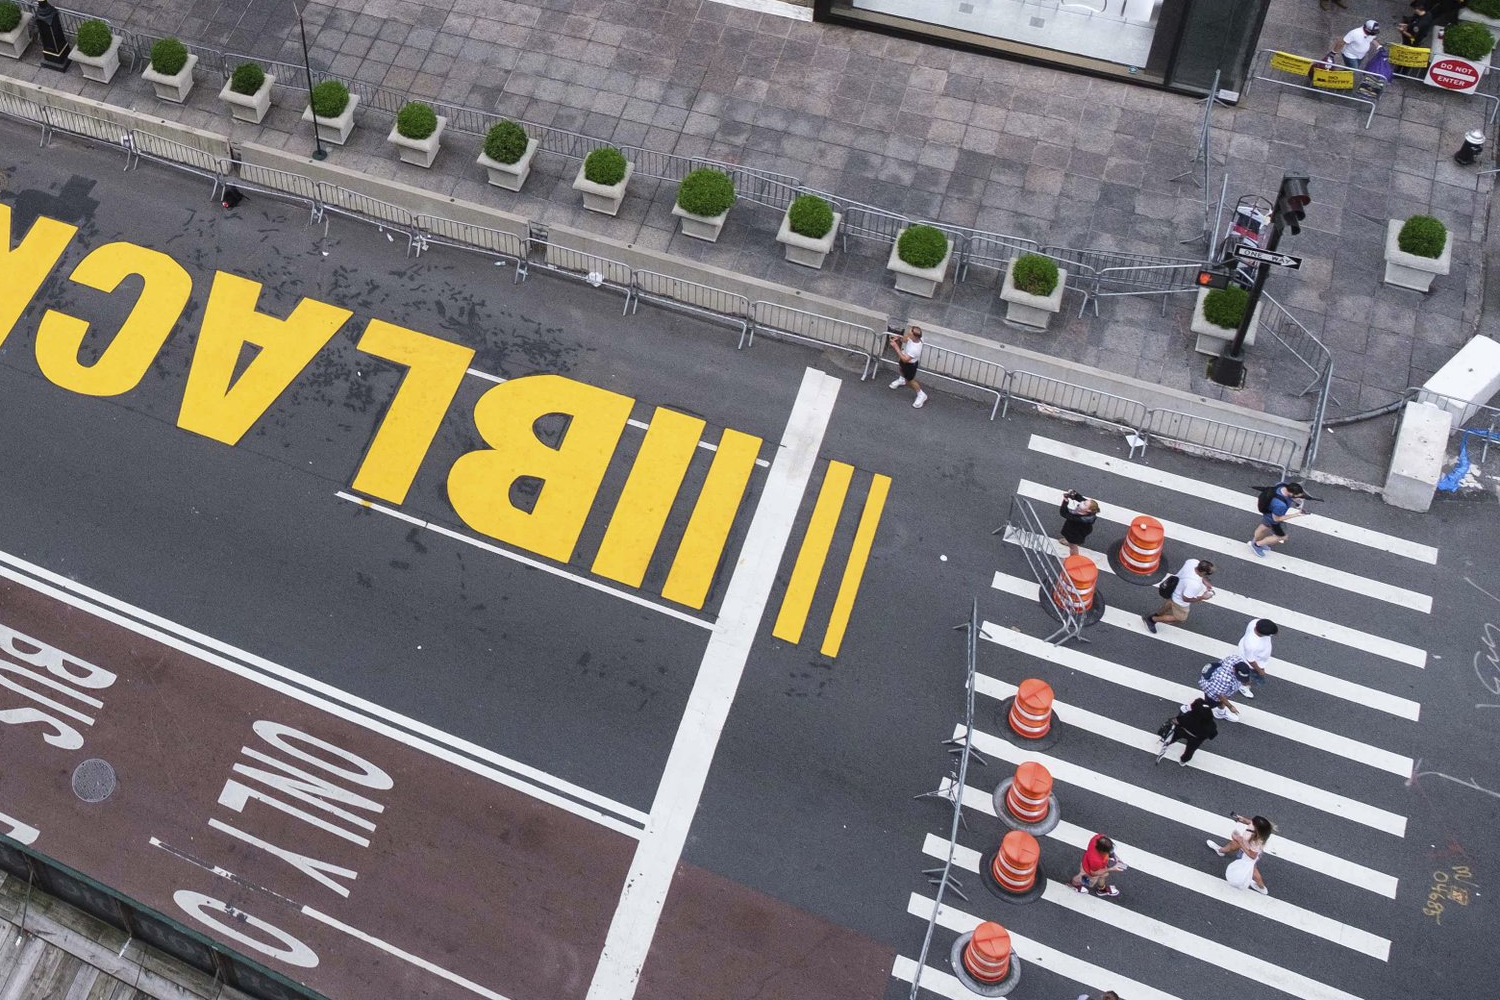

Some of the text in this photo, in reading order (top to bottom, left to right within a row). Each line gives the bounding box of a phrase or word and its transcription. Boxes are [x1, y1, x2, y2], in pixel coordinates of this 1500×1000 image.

[1441, 62, 1473, 75] DO NOT
[1437, 76, 1466, 86] ENTER
[1244, 249, 1291, 264] ONE WAY
[208, 720, 393, 898] ONLY
